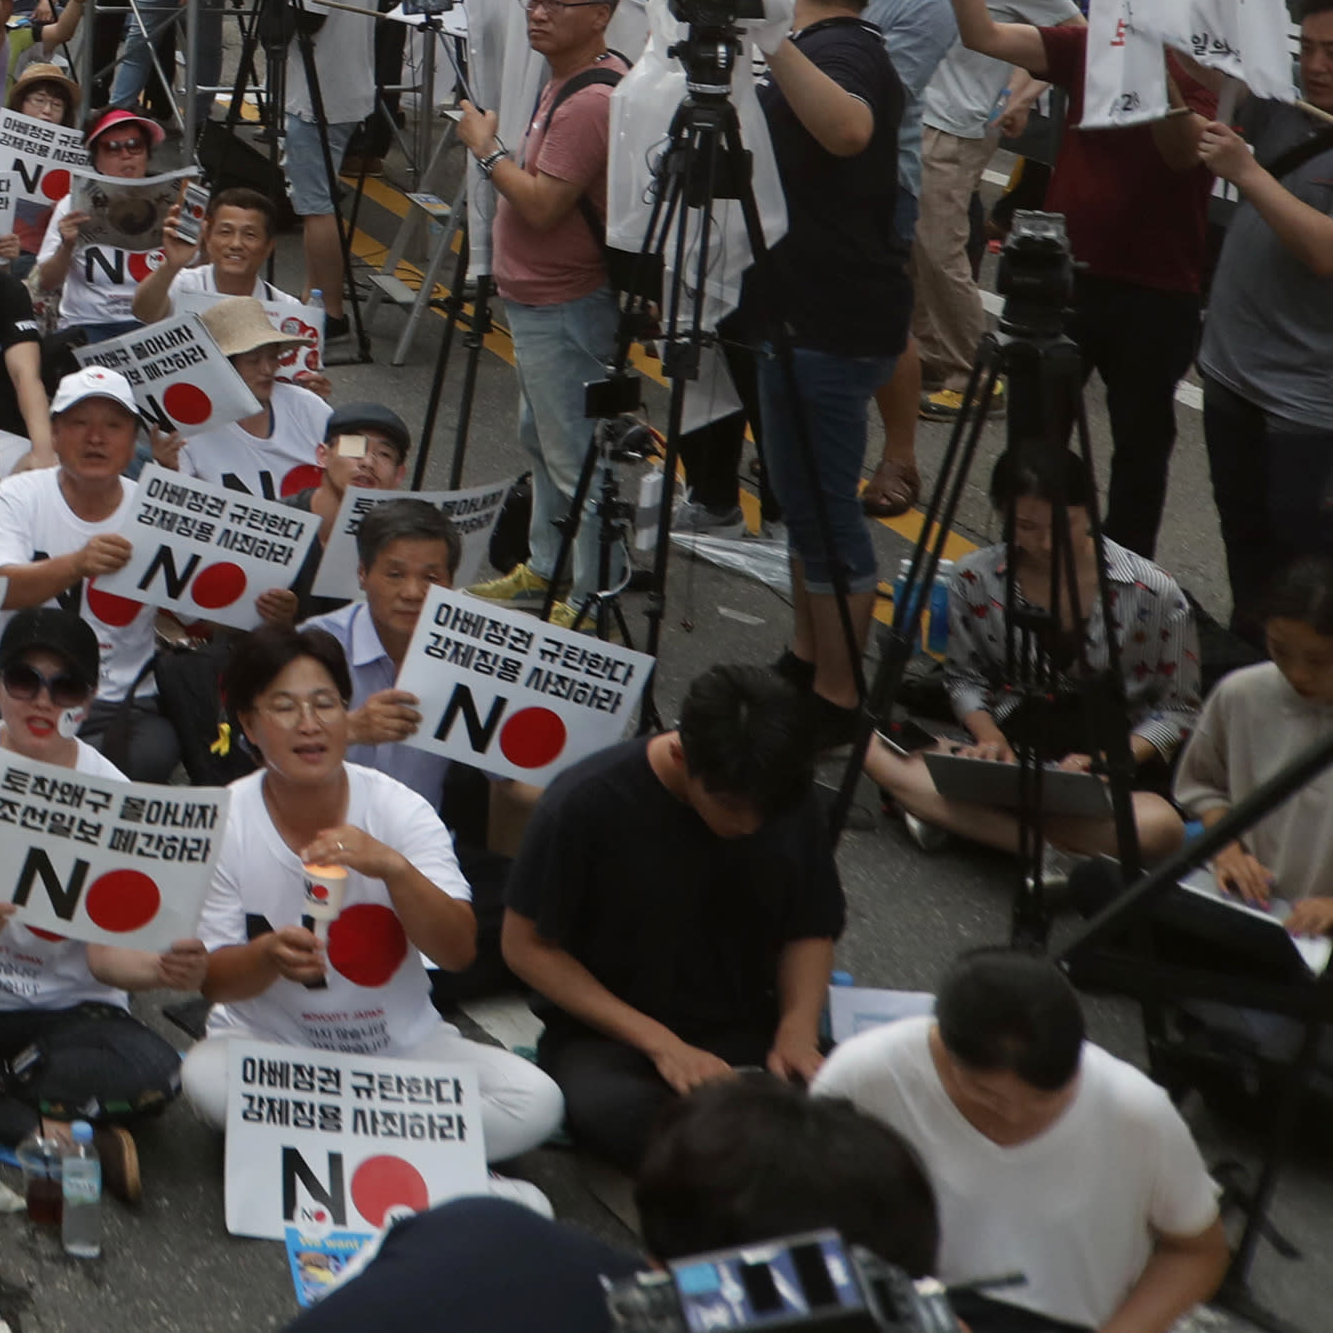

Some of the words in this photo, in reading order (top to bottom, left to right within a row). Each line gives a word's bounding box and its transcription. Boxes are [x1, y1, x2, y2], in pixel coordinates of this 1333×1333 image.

[137, 502, 213, 541] 강제징용
[217, 528, 294, 566] 사죄하라
[147, 476, 224, 516] 아베정권
[229, 502, 305, 543] 규탄한다
[424, 632, 522, 683] 강제징용
[527, 666, 623, 714] 사죄하라
[435, 602, 535, 652] 아베정권
[540, 637, 636, 685] 규탄한다
[1, 767, 114, 814] 토착왜구
[119, 794, 219, 830] 몰아내자
[242, 1057, 341, 1095] 아베정권
[352, 1069, 464, 1102] 규탄한다
[241, 1094, 344, 1134] 강제징용
[353, 1108, 467, 1142] 사죄하라
